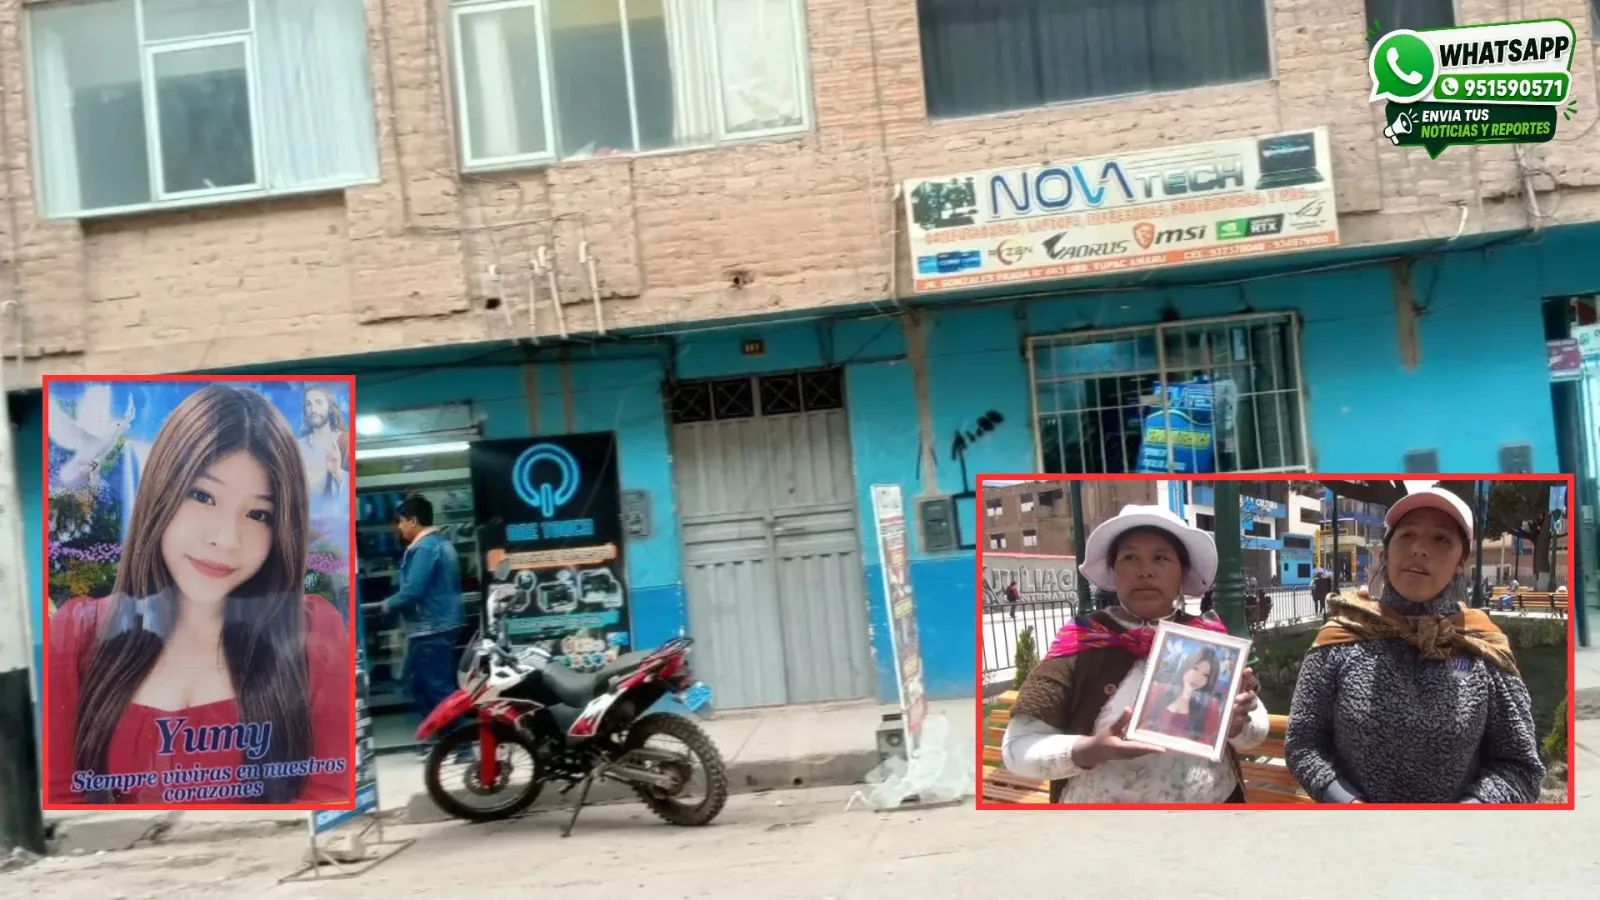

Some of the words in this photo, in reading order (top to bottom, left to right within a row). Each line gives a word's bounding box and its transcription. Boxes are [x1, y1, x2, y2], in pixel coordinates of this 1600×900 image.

[1135, 160, 1244, 199] TECH
[1155, 225, 1208, 245] msi
[1250, 222, 1280, 235] RTX
[988, 566, 1078, 594] JULIAC
